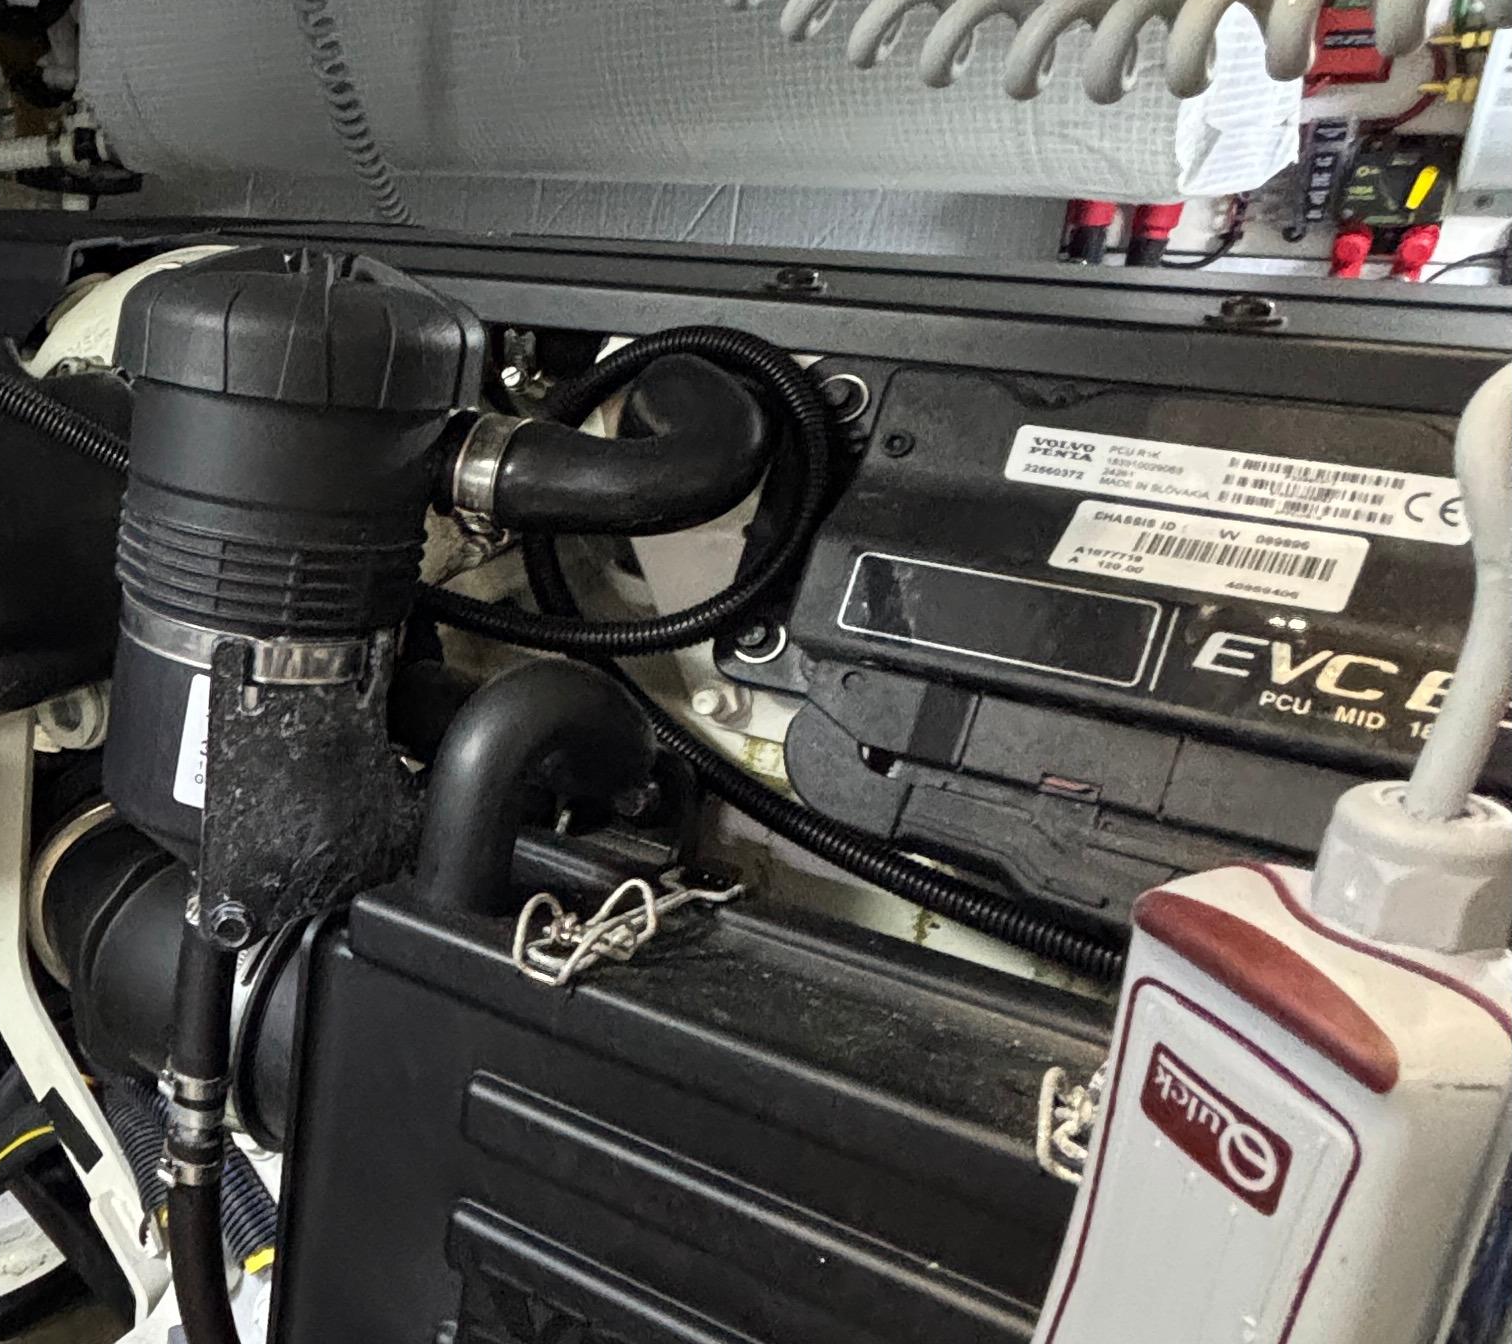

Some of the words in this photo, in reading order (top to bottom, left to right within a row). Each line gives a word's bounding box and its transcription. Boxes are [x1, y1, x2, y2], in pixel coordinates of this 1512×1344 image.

[1028, 446, 1093, 462] PENTA
[1033, 436, 1096, 453] VOLVO
[1099, 476, 1131, 488] MADE
[1095, 511, 1156, 529] CHASSIS
[1160, 521, 1176, 531] ID
[1192, 631, 1400, 702] EVC
[1259, 690, 1312, 715] PCU
[1333, 705, 1387, 731] MID
[1152, 1053, 1278, 1193] Quick
